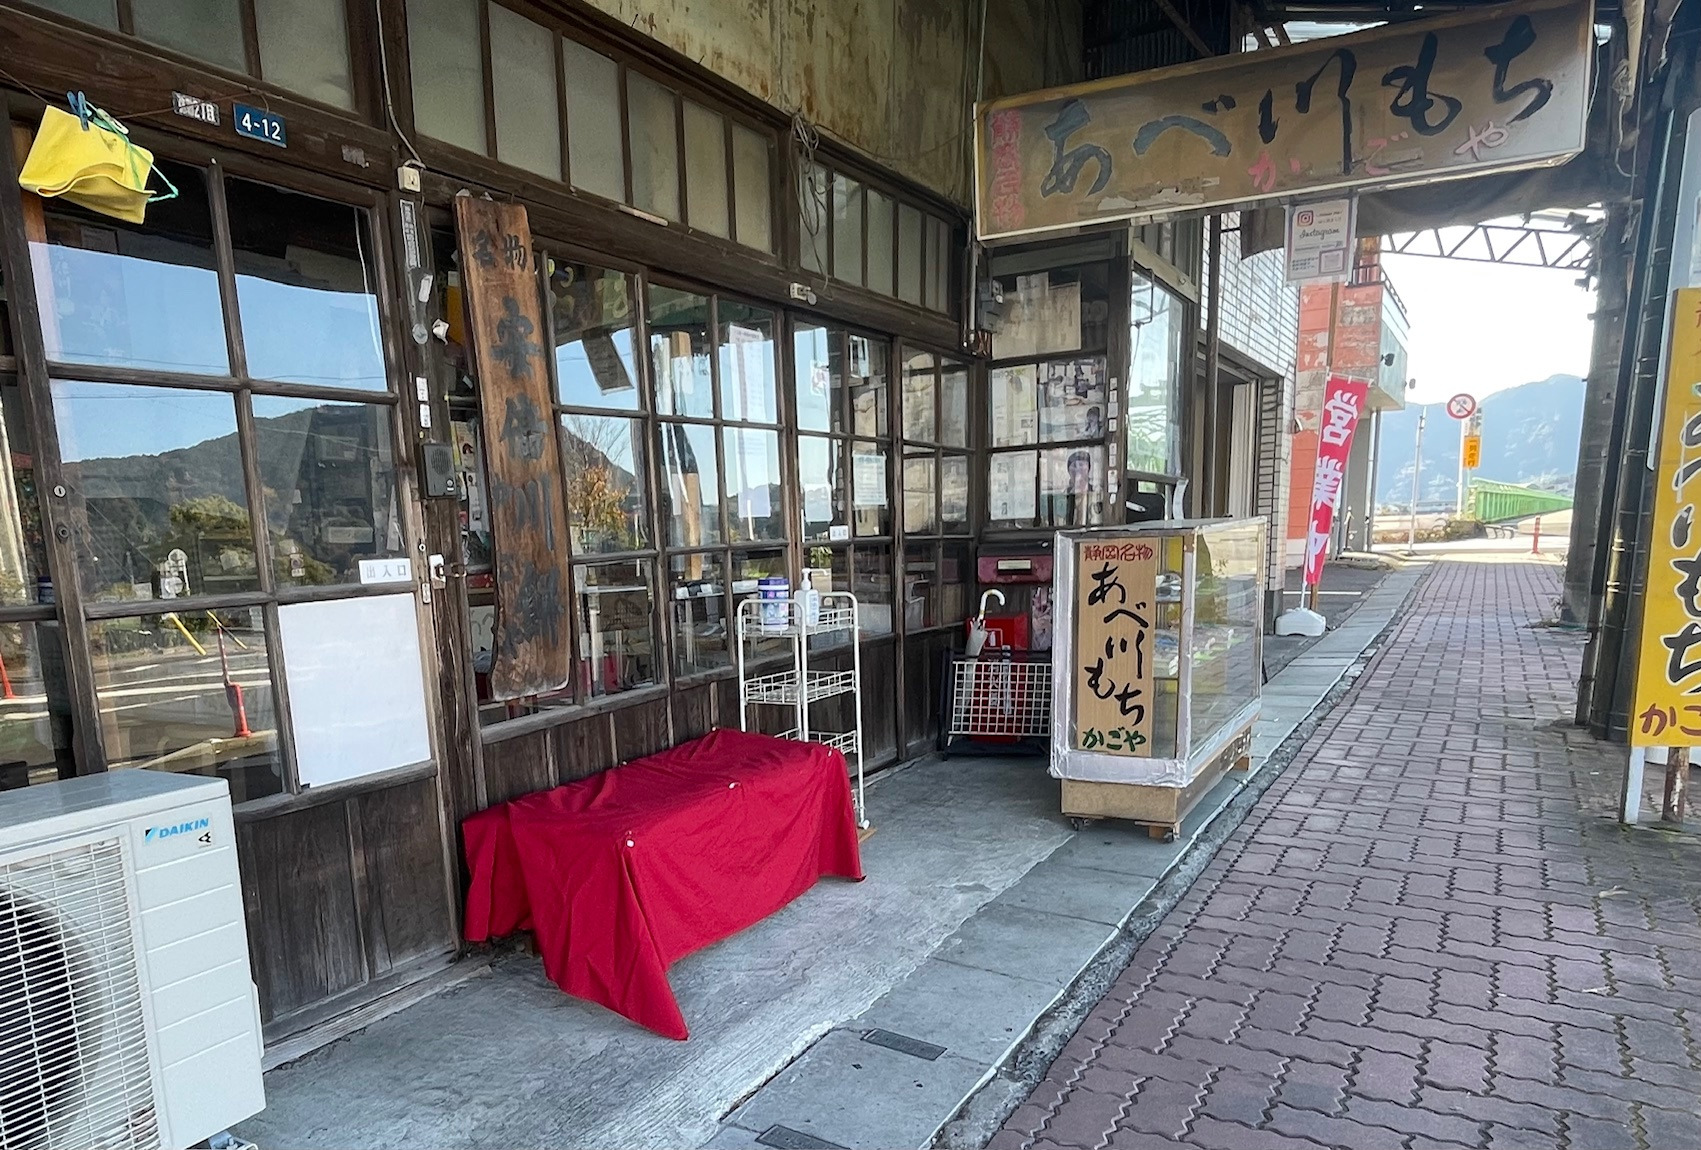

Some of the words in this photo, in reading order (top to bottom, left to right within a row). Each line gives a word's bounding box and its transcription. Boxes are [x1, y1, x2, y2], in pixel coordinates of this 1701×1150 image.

[1040, 14, 1554, 199] あべ川もち
[241, 112, 282, 141] 4-12
[1300, 228, 1340, 241] Instagram
[1307, 389, 1359, 574] 営業中
[1083, 543, 1154, 562] 静岡名物
[366, 564, 407, 579] 出入口
[1084, 561, 1150, 727] あべ川もち
[1082, 726, 1148, 752] かごや
[159, 818, 209, 838] DAIKIN
